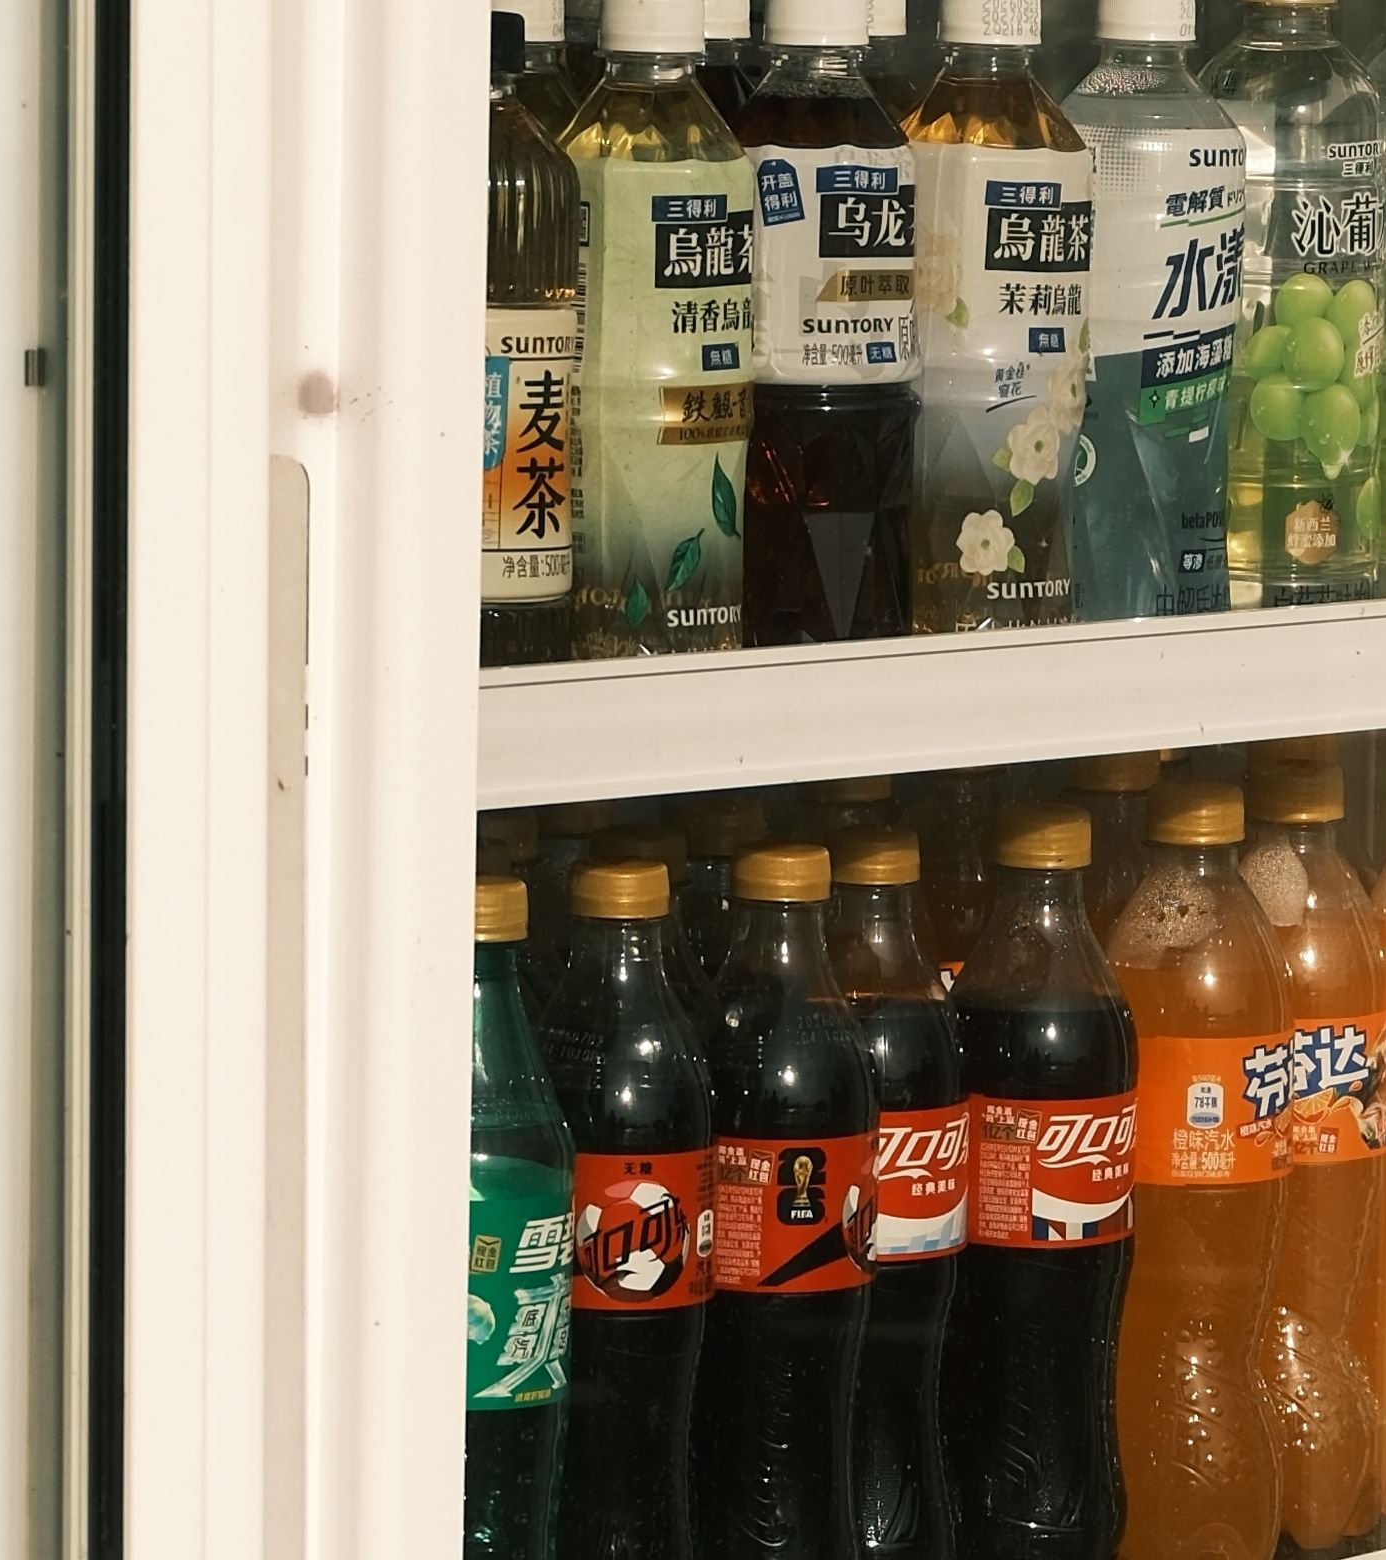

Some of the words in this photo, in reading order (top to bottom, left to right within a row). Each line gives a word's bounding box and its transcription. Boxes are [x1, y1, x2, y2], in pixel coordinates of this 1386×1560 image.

[761, 170, 795, 192] 开盖
[833, 171, 887, 191] 三得利
[763, 191, 798, 212] 得利
[1000, 185, 1055, 205] 三得利
[666, 199, 718, 220] 三得利
[992, 212, 1088, 263] 烏龍茶
[998, 282, 1083, 316] 茉莉烏龍
[802, 316, 895, 335] SUNTORY
[514, 369, 567, 539] 麦茶
[986, 577, 1071, 600] SUNTORY
[1172, 1129, 1235, 1151] 橙味汽水
[624, 1162, 653, 1176] 无糖
[1092, 1162, 1130, 1182] 经典美味
[911, 1178, 956, 1197] 经典美味
[791, 1209, 814, 1220] FIFA
